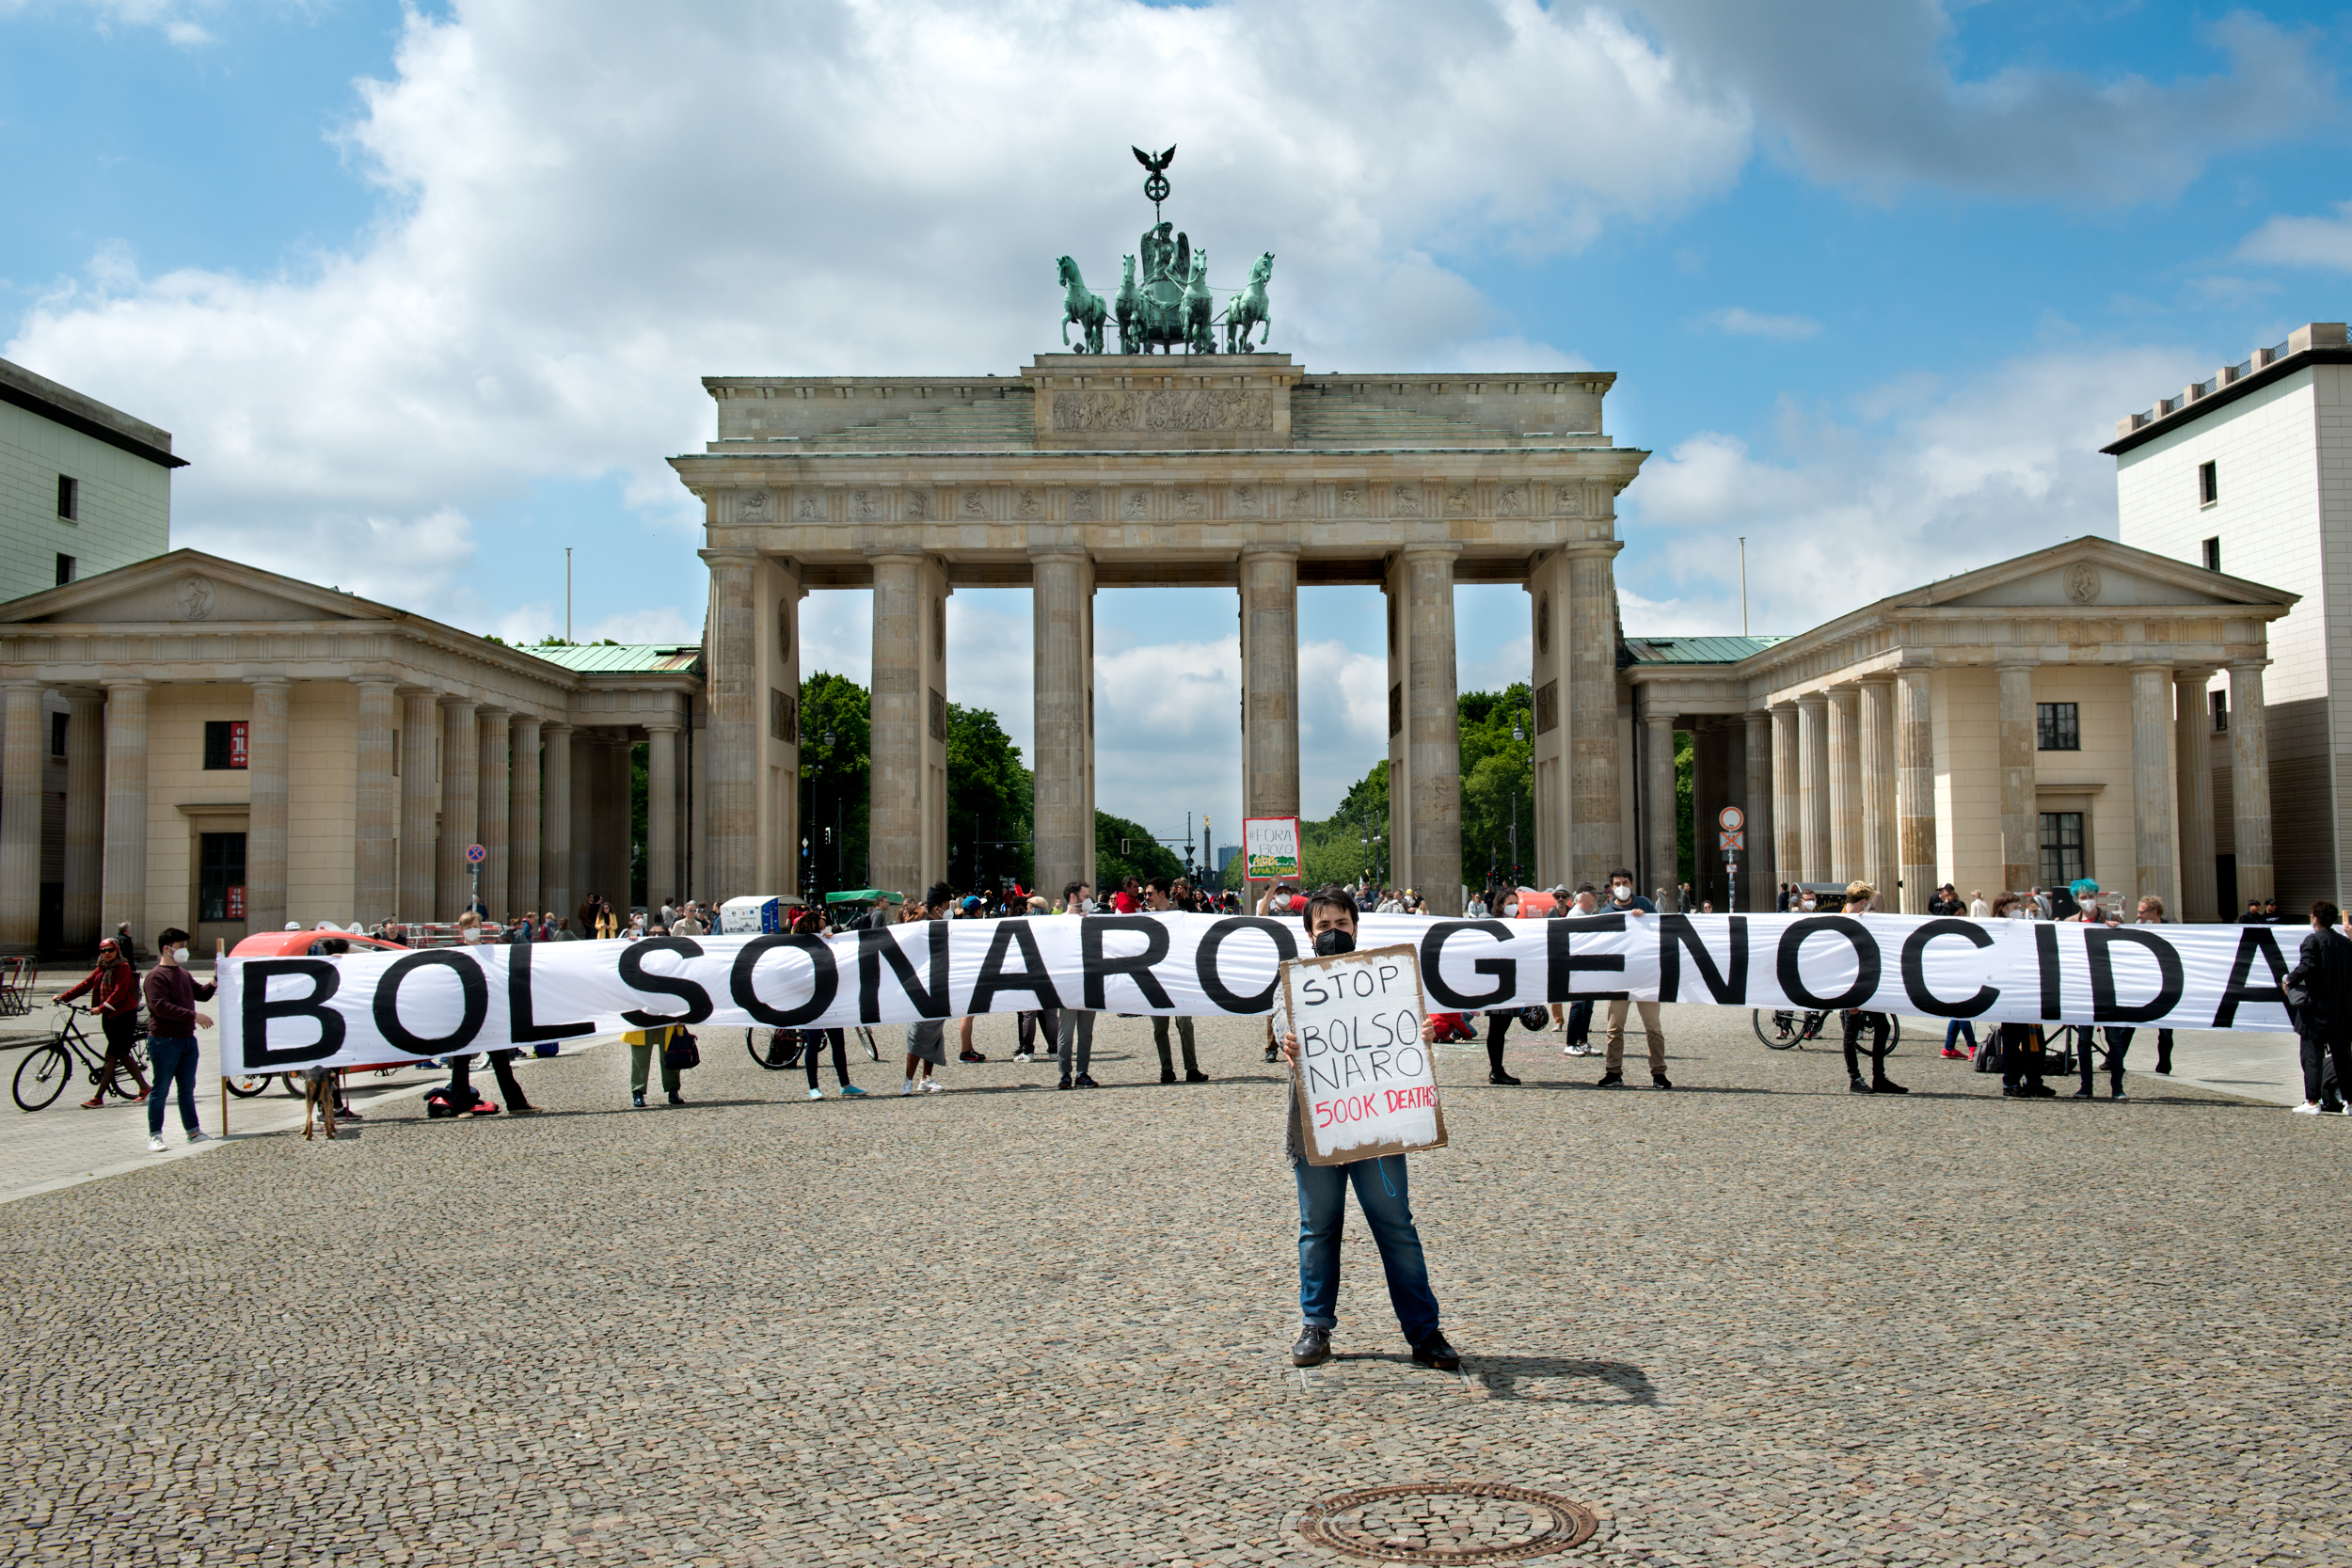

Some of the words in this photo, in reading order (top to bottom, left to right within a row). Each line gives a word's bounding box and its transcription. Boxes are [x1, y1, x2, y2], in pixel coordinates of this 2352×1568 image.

[1248, 829, 1292, 843] #FORA
[1259, 844, 1294, 856] BOZO
[1251, 865, 1298, 876] AMAZONAS
[1254, 856, 1277, 867] SOS
[242, 915, 1298, 1069] BOLSONARO
[1420, 913, 2298, 1029] GENOCIDA
[1302, 965, 1399, 1006] STOP
[1302, 1009, 1419, 1058] BOLSO
[1309, 1047, 1423, 1094] NARO
[1315, 1092, 1379, 1129] 500K
[1383, 1085, 1437, 1114] DEATHS
